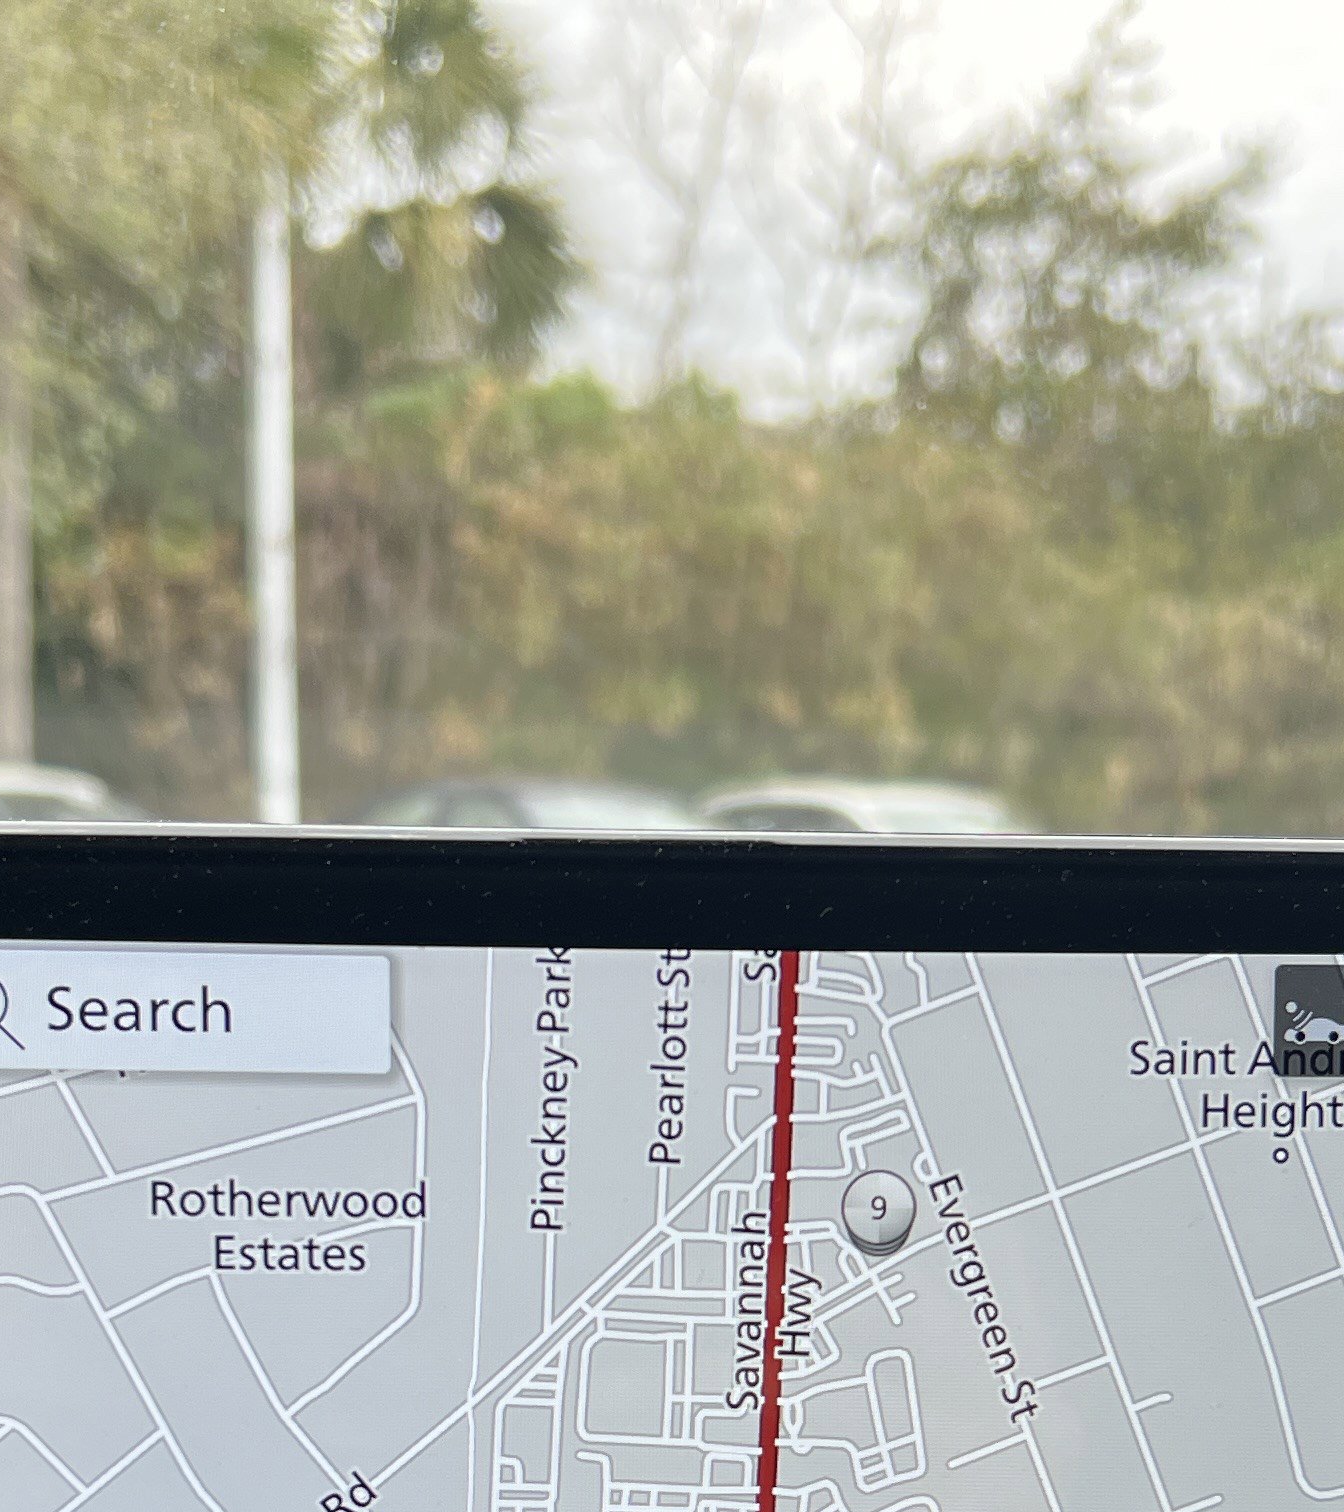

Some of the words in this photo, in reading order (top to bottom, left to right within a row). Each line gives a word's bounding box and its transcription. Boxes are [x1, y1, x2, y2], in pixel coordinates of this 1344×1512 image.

[536, 947, 571, 1033] Park
[657, 948, 692, 988] St
[47, 985, 233, 1033] Search
[649, 1000, 689, 1165] Pearlott
[1130, 1041, 1236, 1076] Saint
[531, 1045, 576, 1232] Pinckney
[150, 1178, 427, 1219] Rotherwood
[870, 1195, 888, 1221] 9
[213, 1234, 367, 1272] Estates
[726, 1211, 767, 1410] Savannah
[777, 1267, 823, 1356] Hwy
[929, 1173, 1016, 1374] Evergreen
[1002, 1379, 1039, 1424] St
